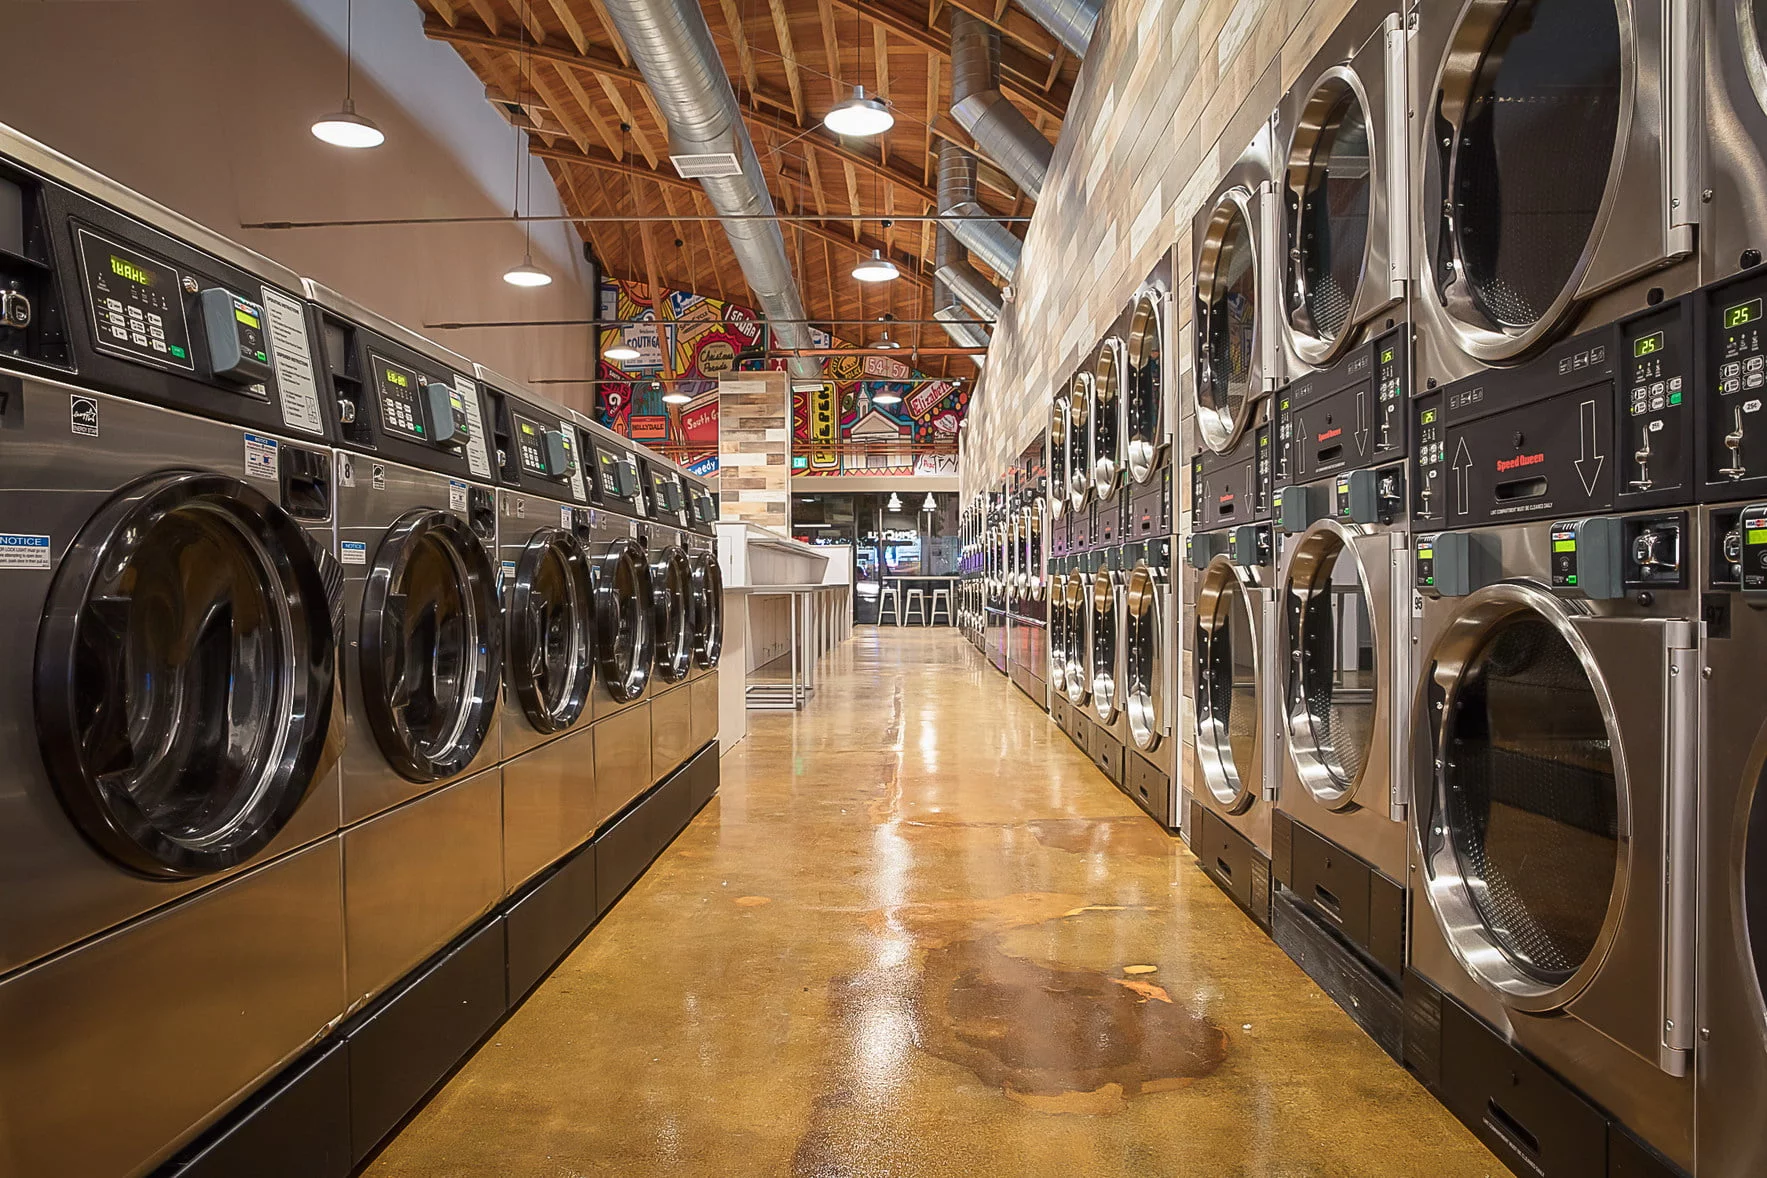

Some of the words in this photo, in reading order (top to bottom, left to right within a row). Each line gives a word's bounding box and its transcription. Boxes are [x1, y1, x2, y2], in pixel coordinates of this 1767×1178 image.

[1732, 307, 1748, 326] 25
[1641, 338, 1655, 354] 25
[345, 463, 350, 479] 8
[1496, 455, 1519, 473] Speed
[1520, 453, 1544, 466] Queen
[0, 536, 42, 546] NOTICE
